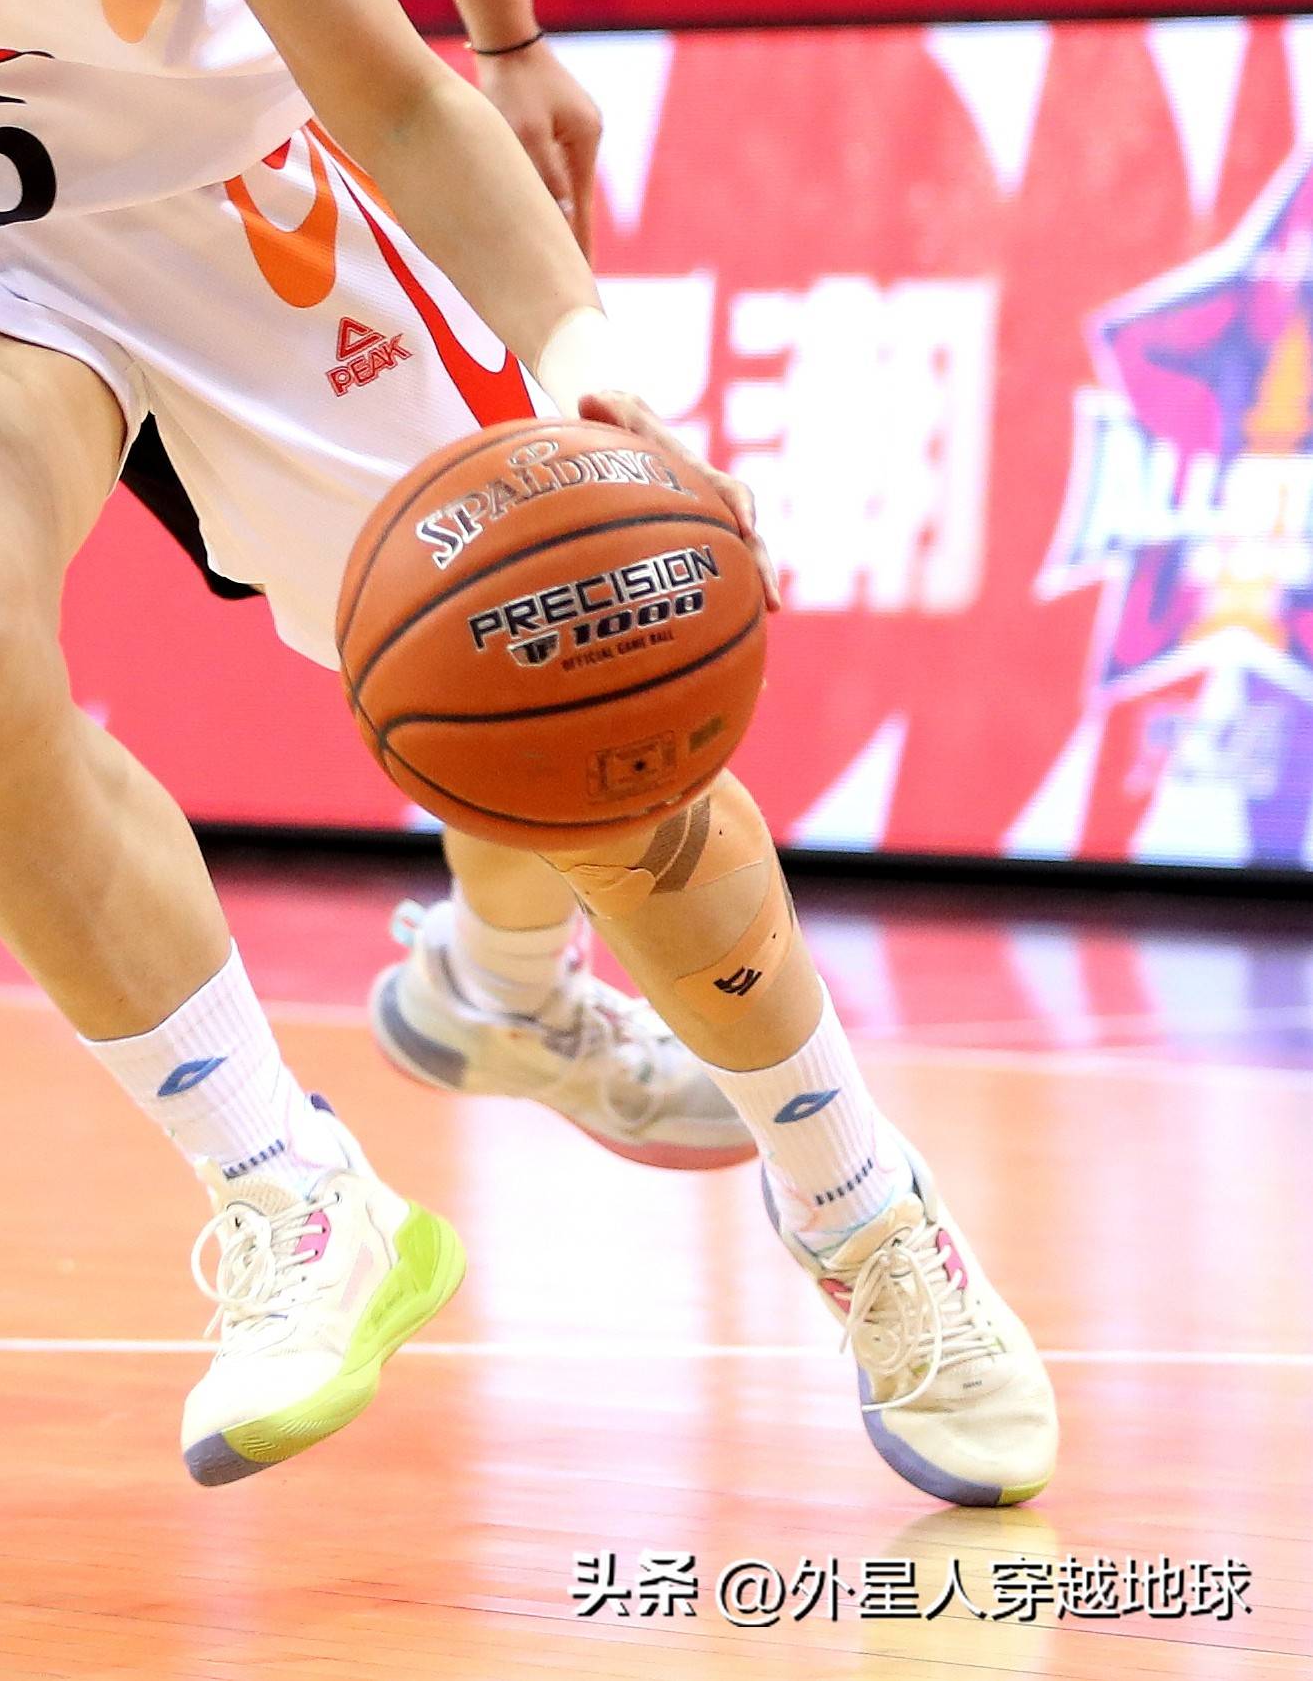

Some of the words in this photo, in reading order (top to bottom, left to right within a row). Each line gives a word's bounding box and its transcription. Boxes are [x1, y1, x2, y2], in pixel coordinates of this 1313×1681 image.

[325, 332, 414, 398] PEAK
[415, 446, 699, 570] SPALDING
[466, 545, 722, 653] PRECISION
[571, 588, 706, 648] 1000
